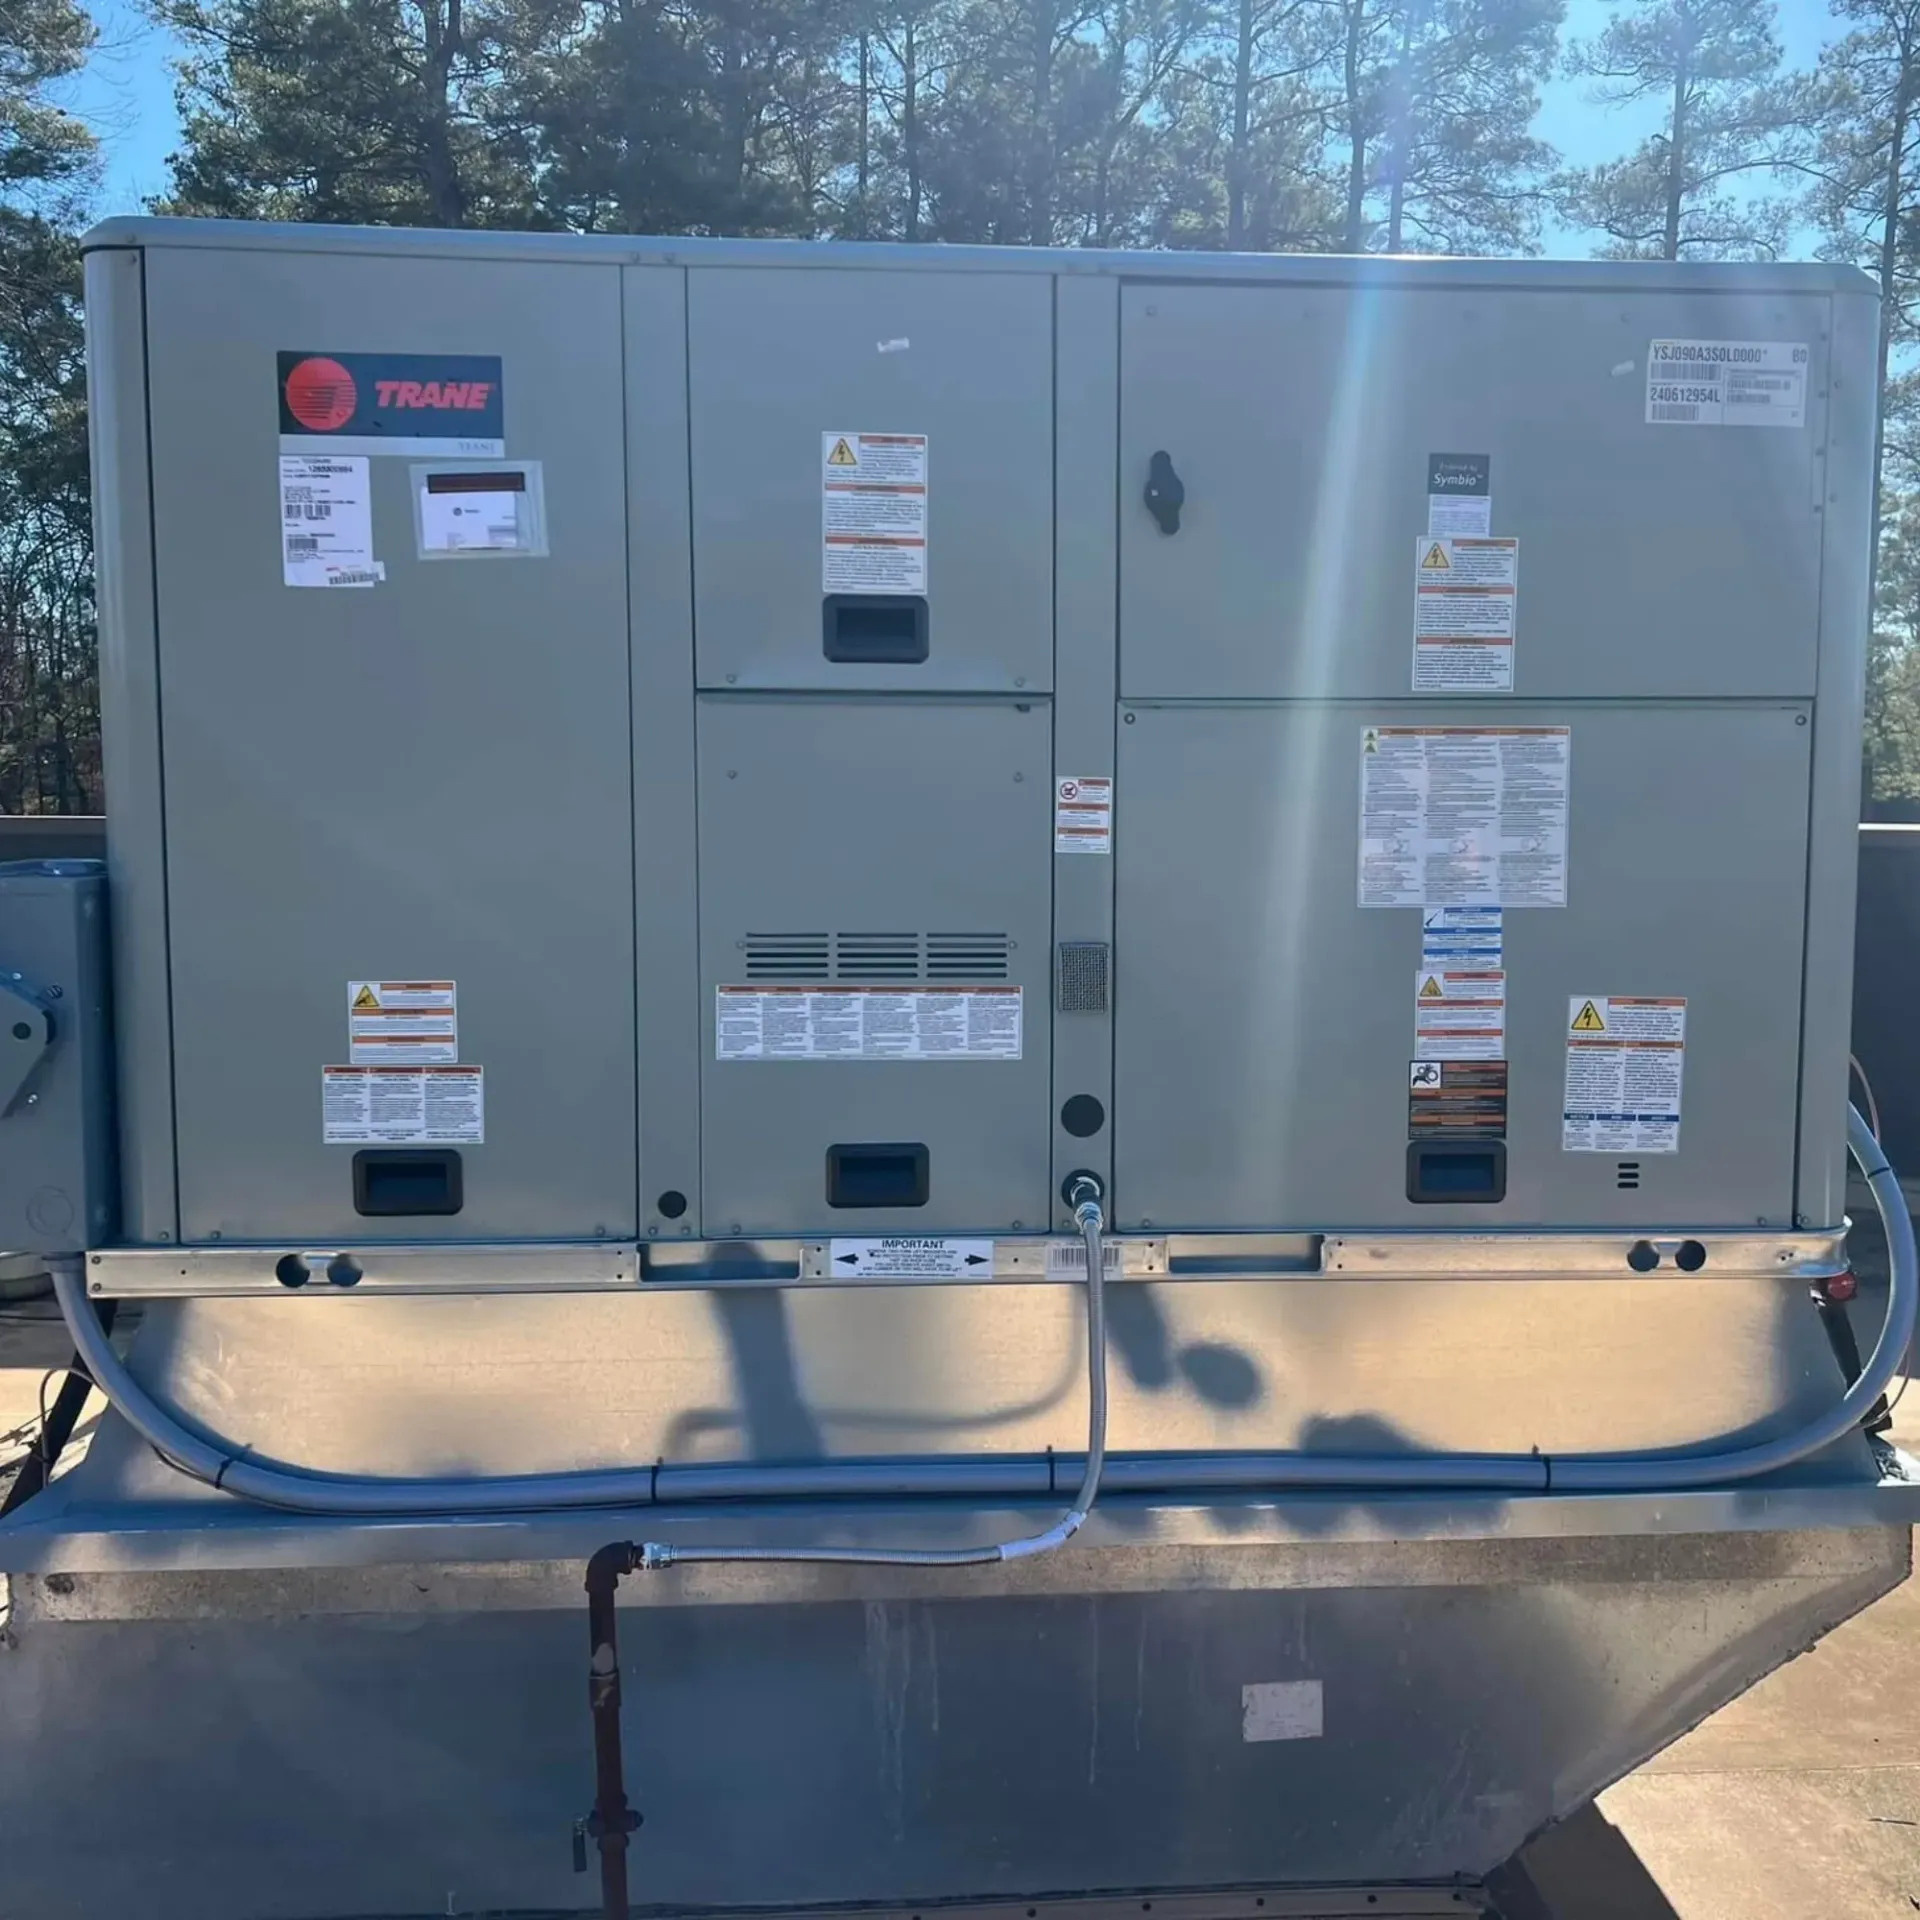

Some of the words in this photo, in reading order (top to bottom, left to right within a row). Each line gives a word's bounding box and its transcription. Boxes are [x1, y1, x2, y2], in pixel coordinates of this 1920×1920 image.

[375, 380, 488, 409] TRANE
[1650, 387, 1721, 403] 240612954L
[882, 1239, 944, 1249] IMPORTANT
